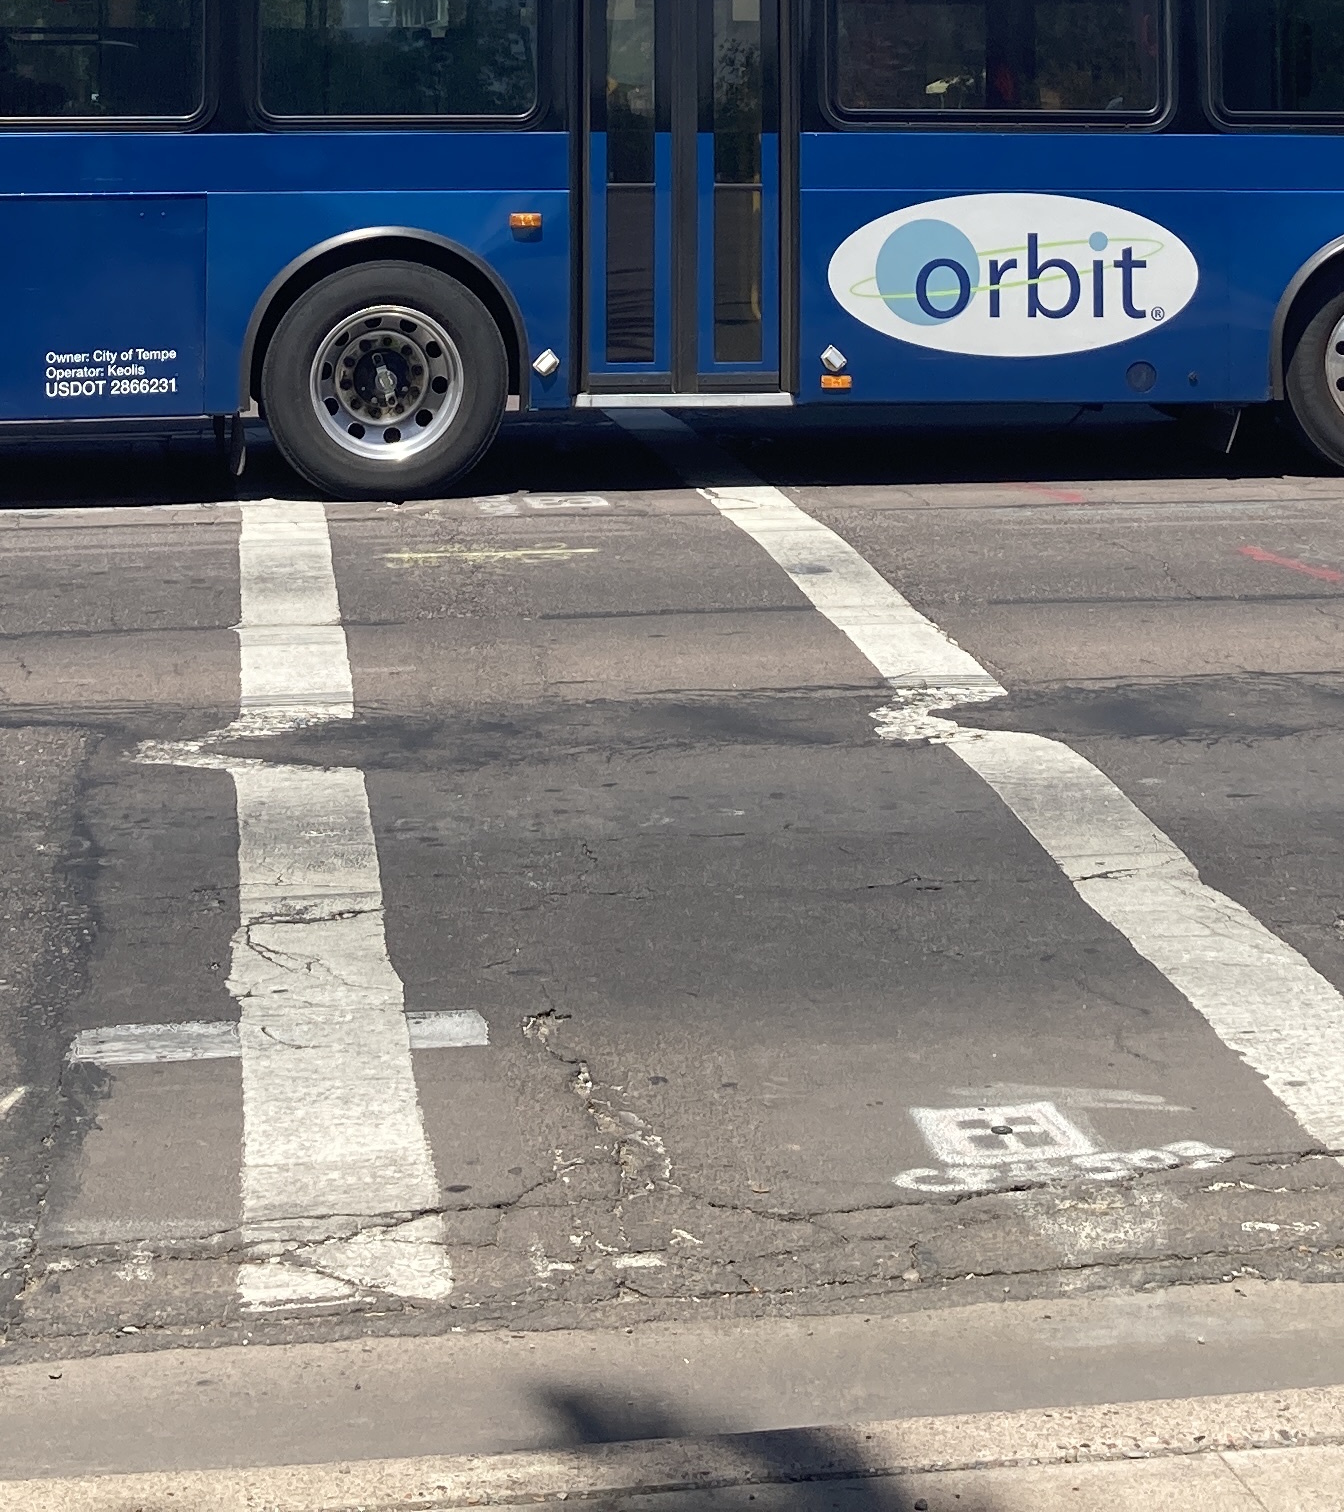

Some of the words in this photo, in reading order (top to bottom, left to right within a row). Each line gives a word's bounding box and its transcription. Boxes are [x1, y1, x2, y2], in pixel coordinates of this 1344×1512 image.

[46, 351, 90, 364] Owner:
[93, 350, 117, 364] City
[120, 348, 133, 361] of
[136, 348, 177, 362] Tempe
[46, 367, 105, 380] Operator:
[107, 364, 146, 377] Keolis
[45, 380, 107, 397] USDOT
[110, 377, 177, 395] 2866231
